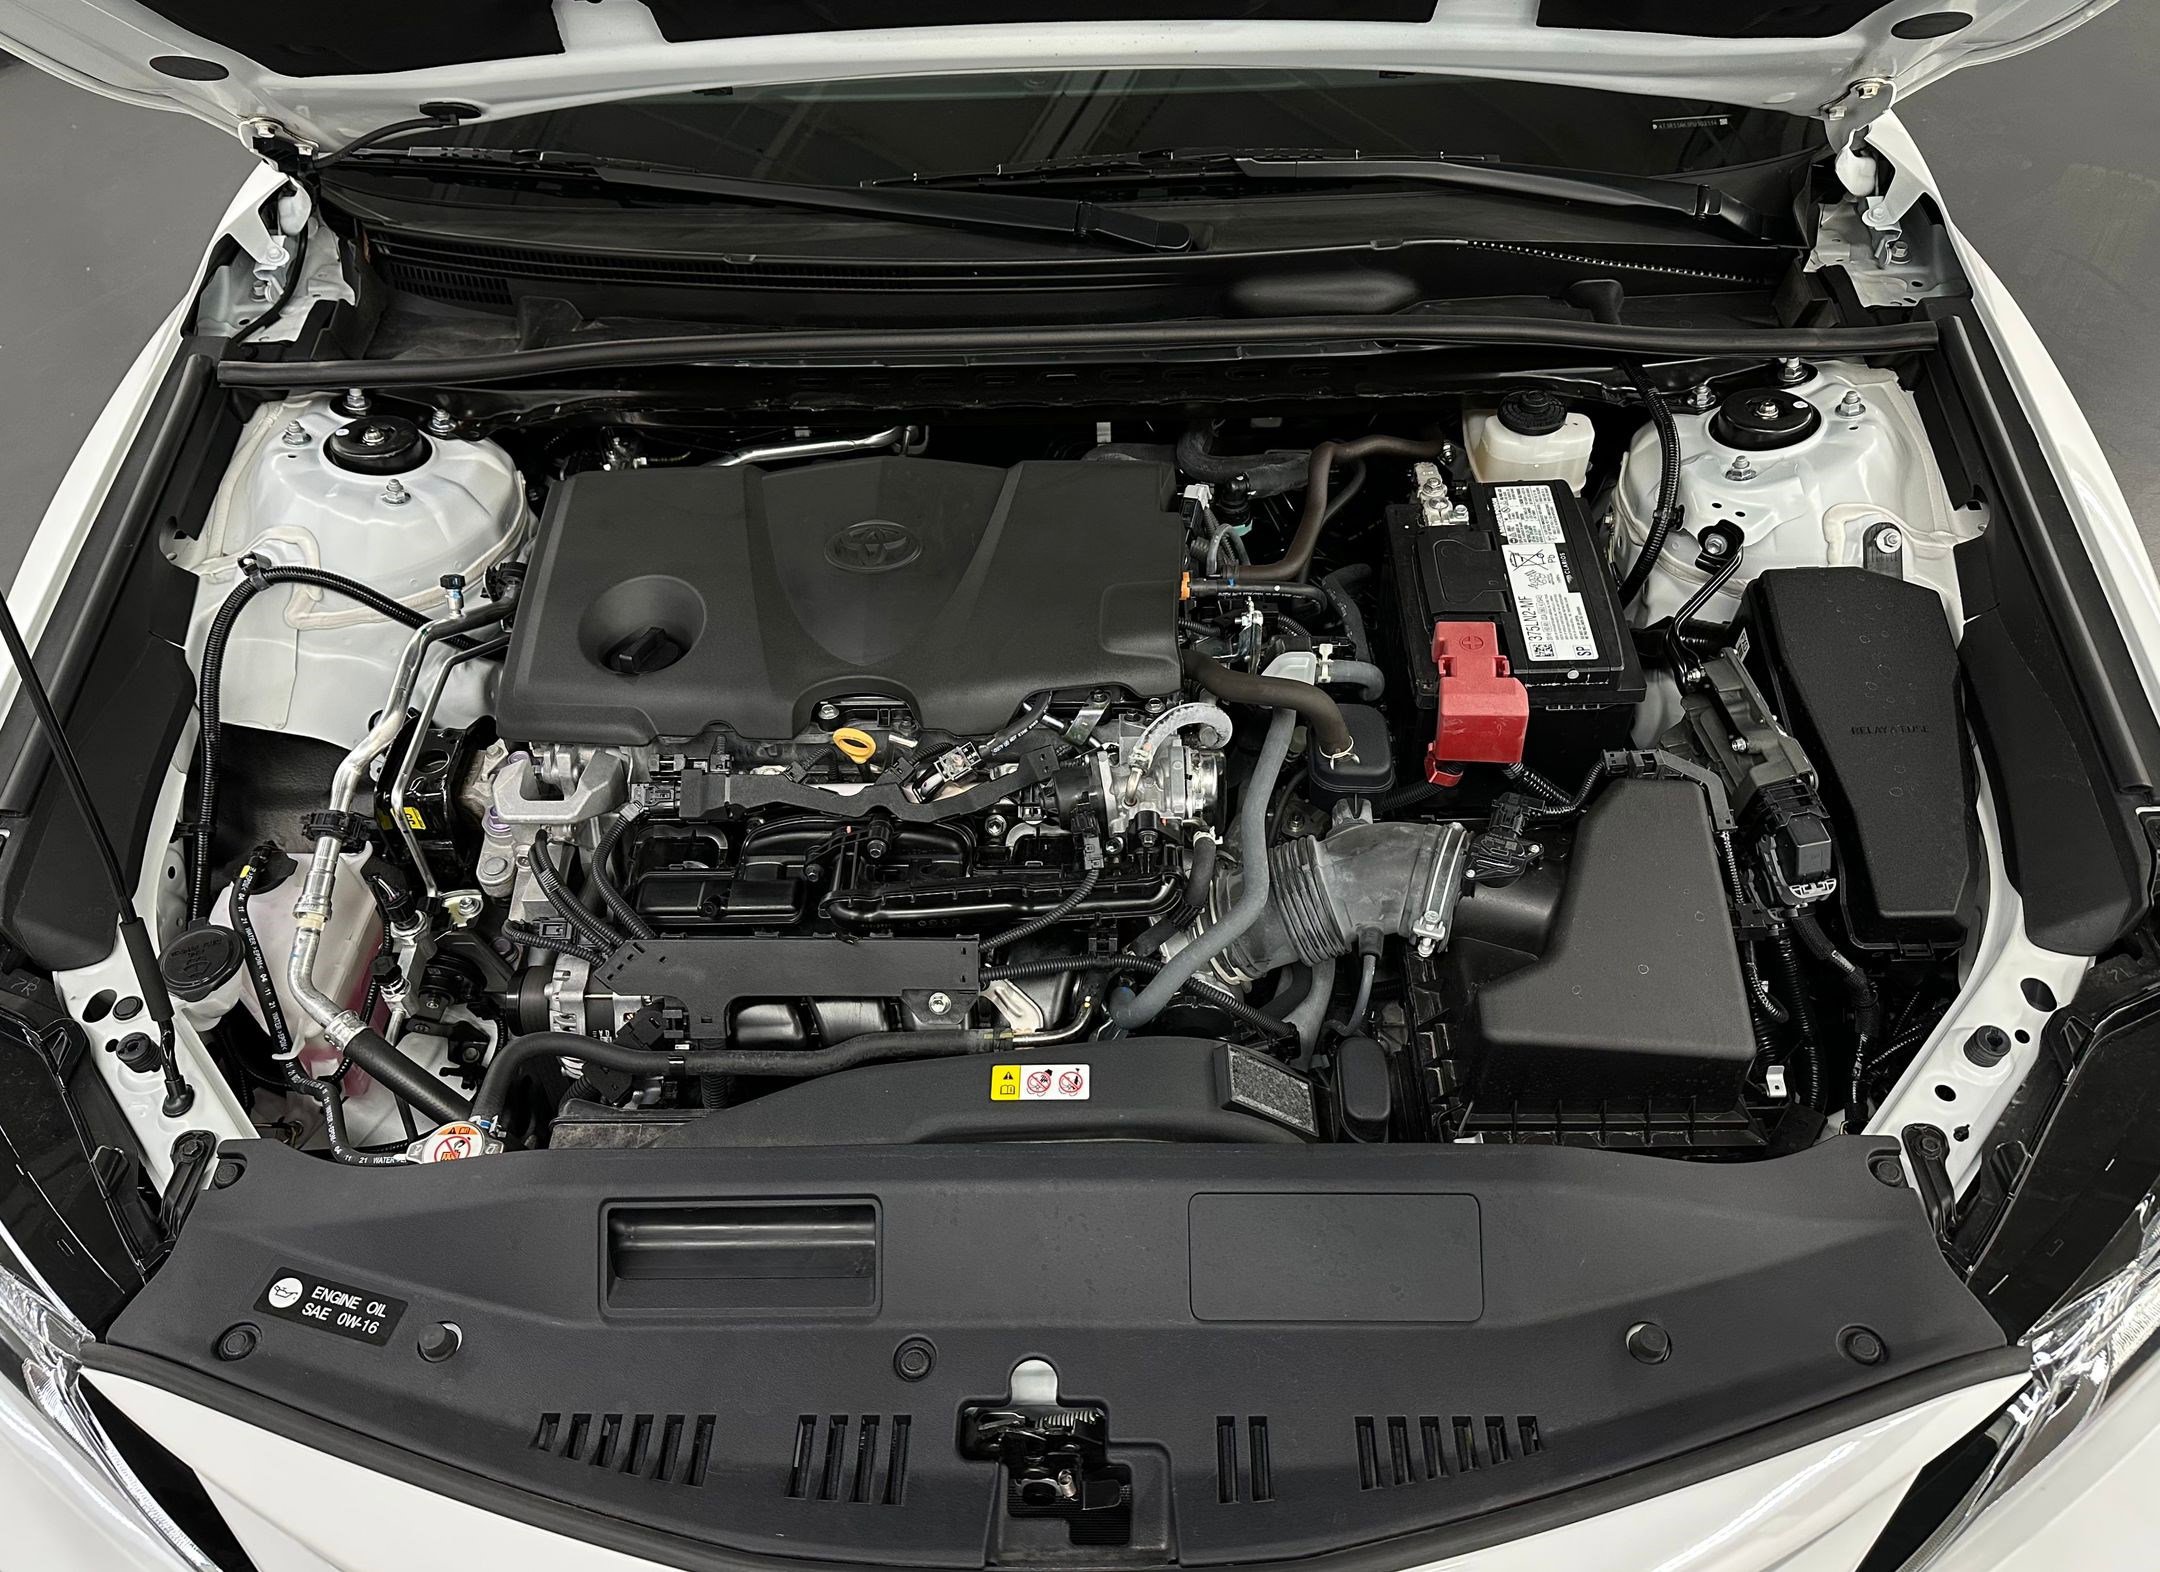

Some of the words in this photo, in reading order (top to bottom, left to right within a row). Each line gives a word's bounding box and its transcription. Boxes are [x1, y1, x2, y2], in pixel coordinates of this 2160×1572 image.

[1559, 552, 1572, 575] CLARIOS
[1517, 595, 1543, 641] 375LN2-MF
[1576, 646, 1592, 657] SP
[244, 927, 257, 946] WATER
[268, 1001, 277, 1009] 21
[372, 1156, 395, 1164] WATER
[311, 1286, 362, 1310] ENGINE
[366, 1301, 387, 1318] OIL
[301, 1302, 333, 1321] SAE
[336, 1312, 380, 1335] 0W-16
